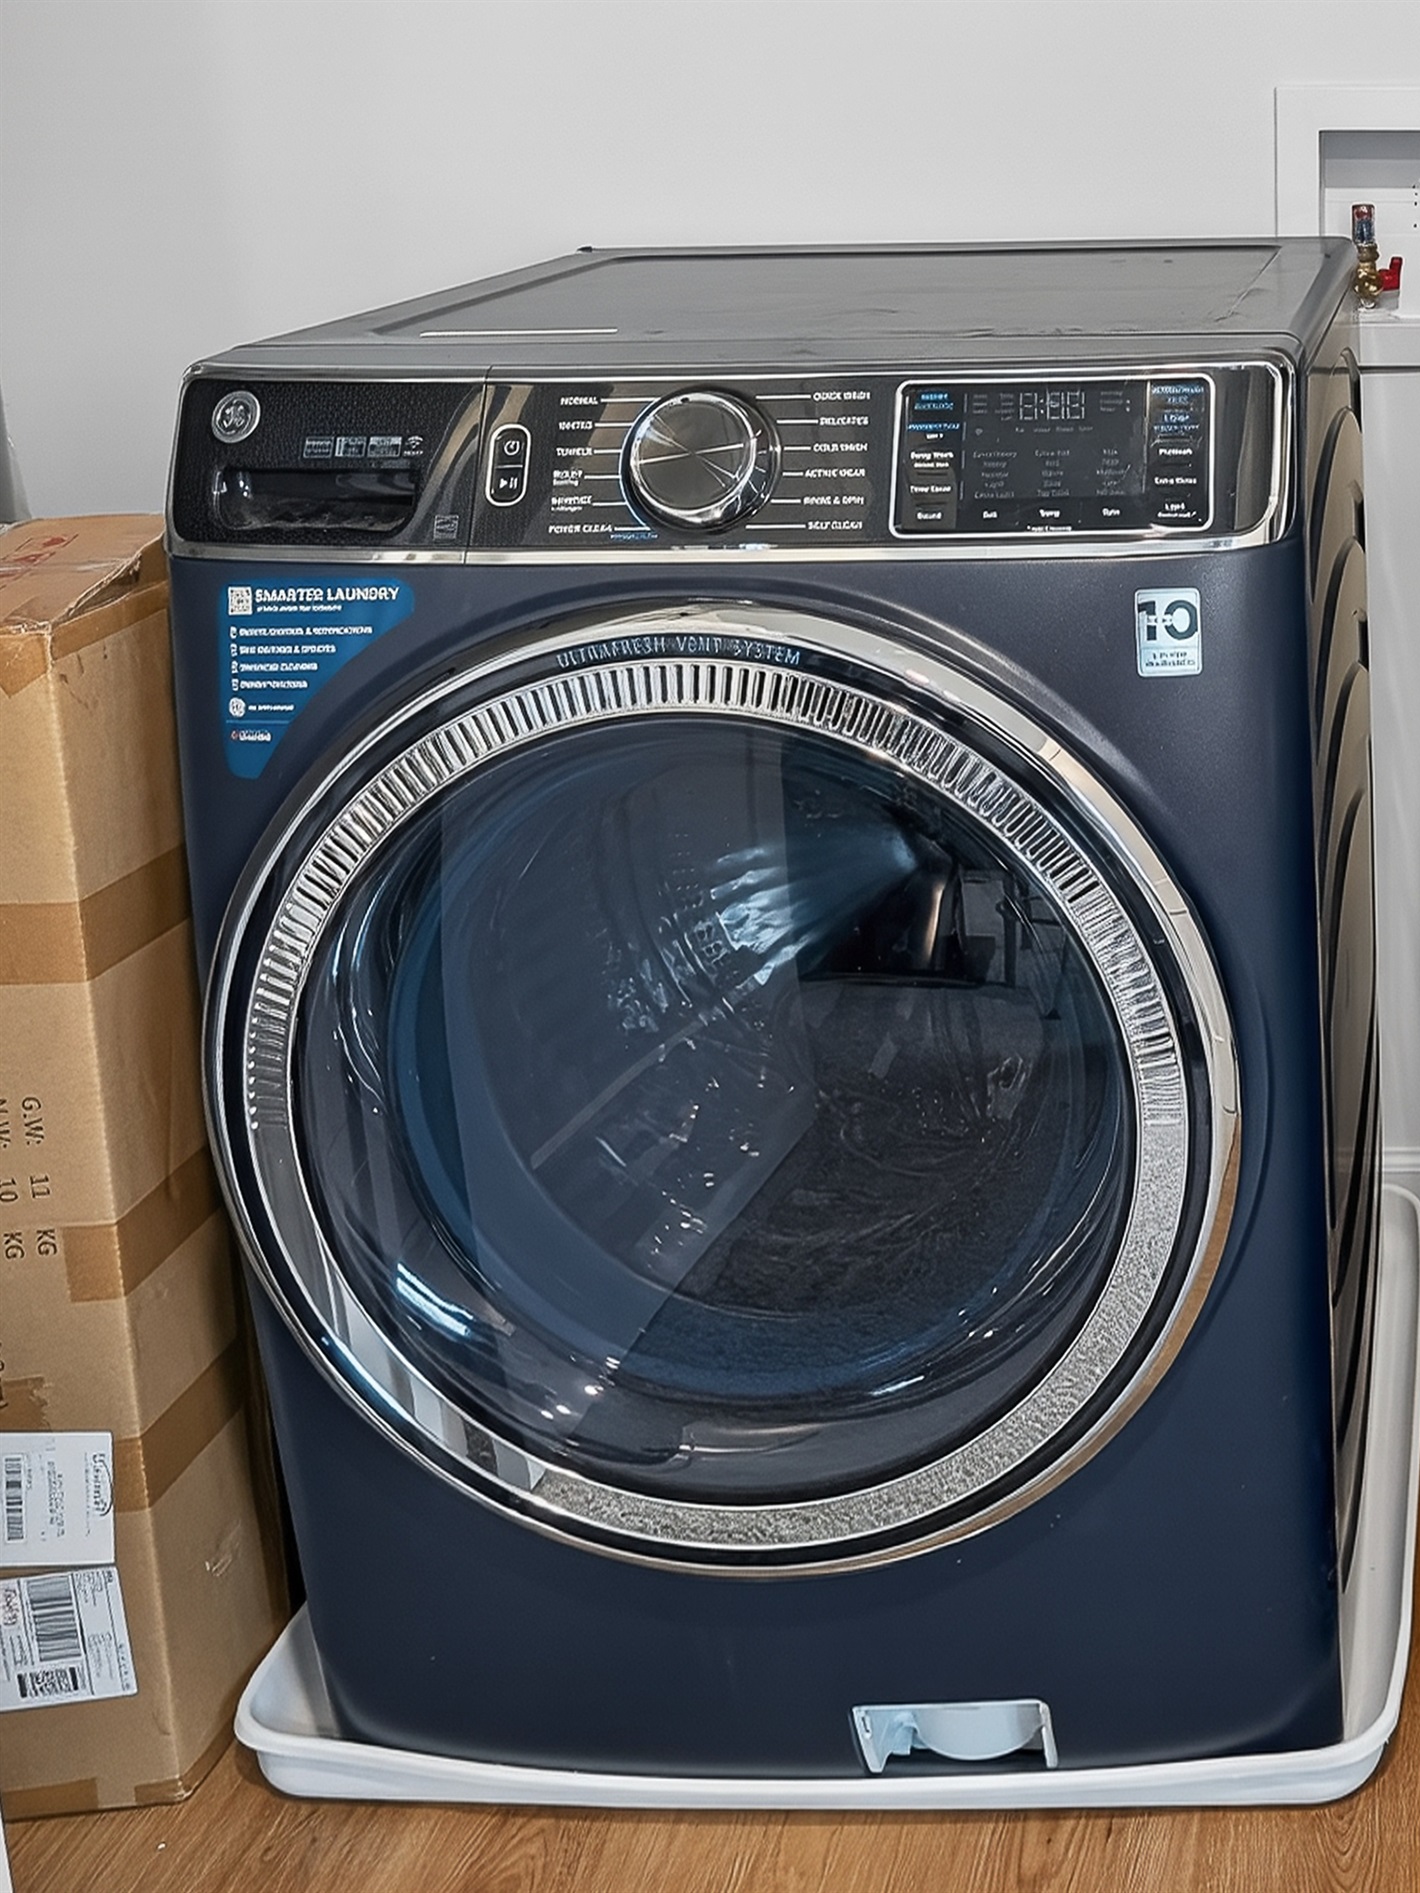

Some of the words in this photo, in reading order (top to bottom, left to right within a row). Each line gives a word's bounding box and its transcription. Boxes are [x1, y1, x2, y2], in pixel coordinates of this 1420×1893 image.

[255, 587, 324, 603] SMARTER
[327, 586, 400, 601] LAUNDRY
[1137, 599, 1199, 641] 10
[22, 1096, 45, 1146] G.W:
[29, 1174, 51, 1200] 11
[3, 1231, 25, 1260] KG
[36, 1228, 58, 1257] KG
